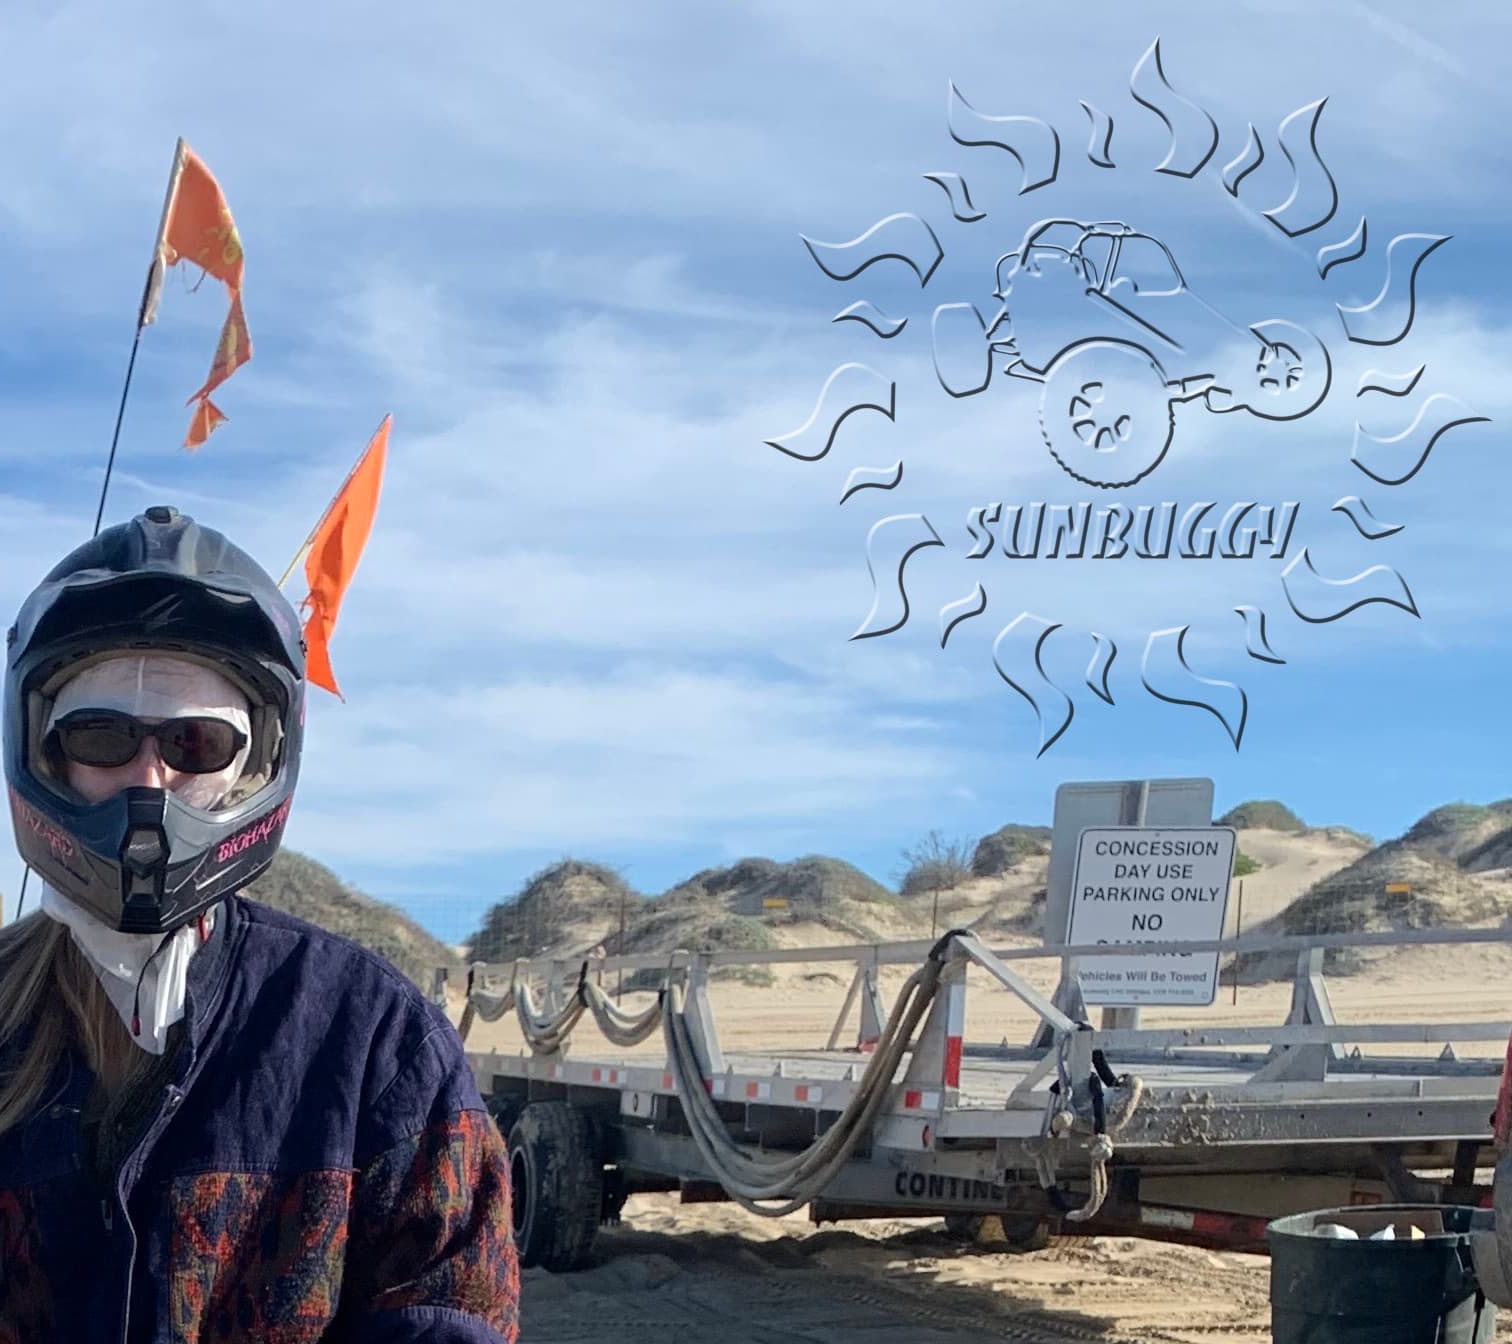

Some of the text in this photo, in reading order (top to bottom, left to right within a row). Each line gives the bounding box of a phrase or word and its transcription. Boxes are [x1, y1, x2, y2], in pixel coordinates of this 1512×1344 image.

[1095, 841, 1219, 857] CONCESSION
[1114, 864, 1194, 879] DAY USE
[1083, 887, 1220, 902] PARKING ONLY
[1131, 914, 1163, 931] NO
[1126, 971, 1148, 982] Will
[1151, 972, 1166, 982] Be
[1170, 971, 1207, 982] Towed
